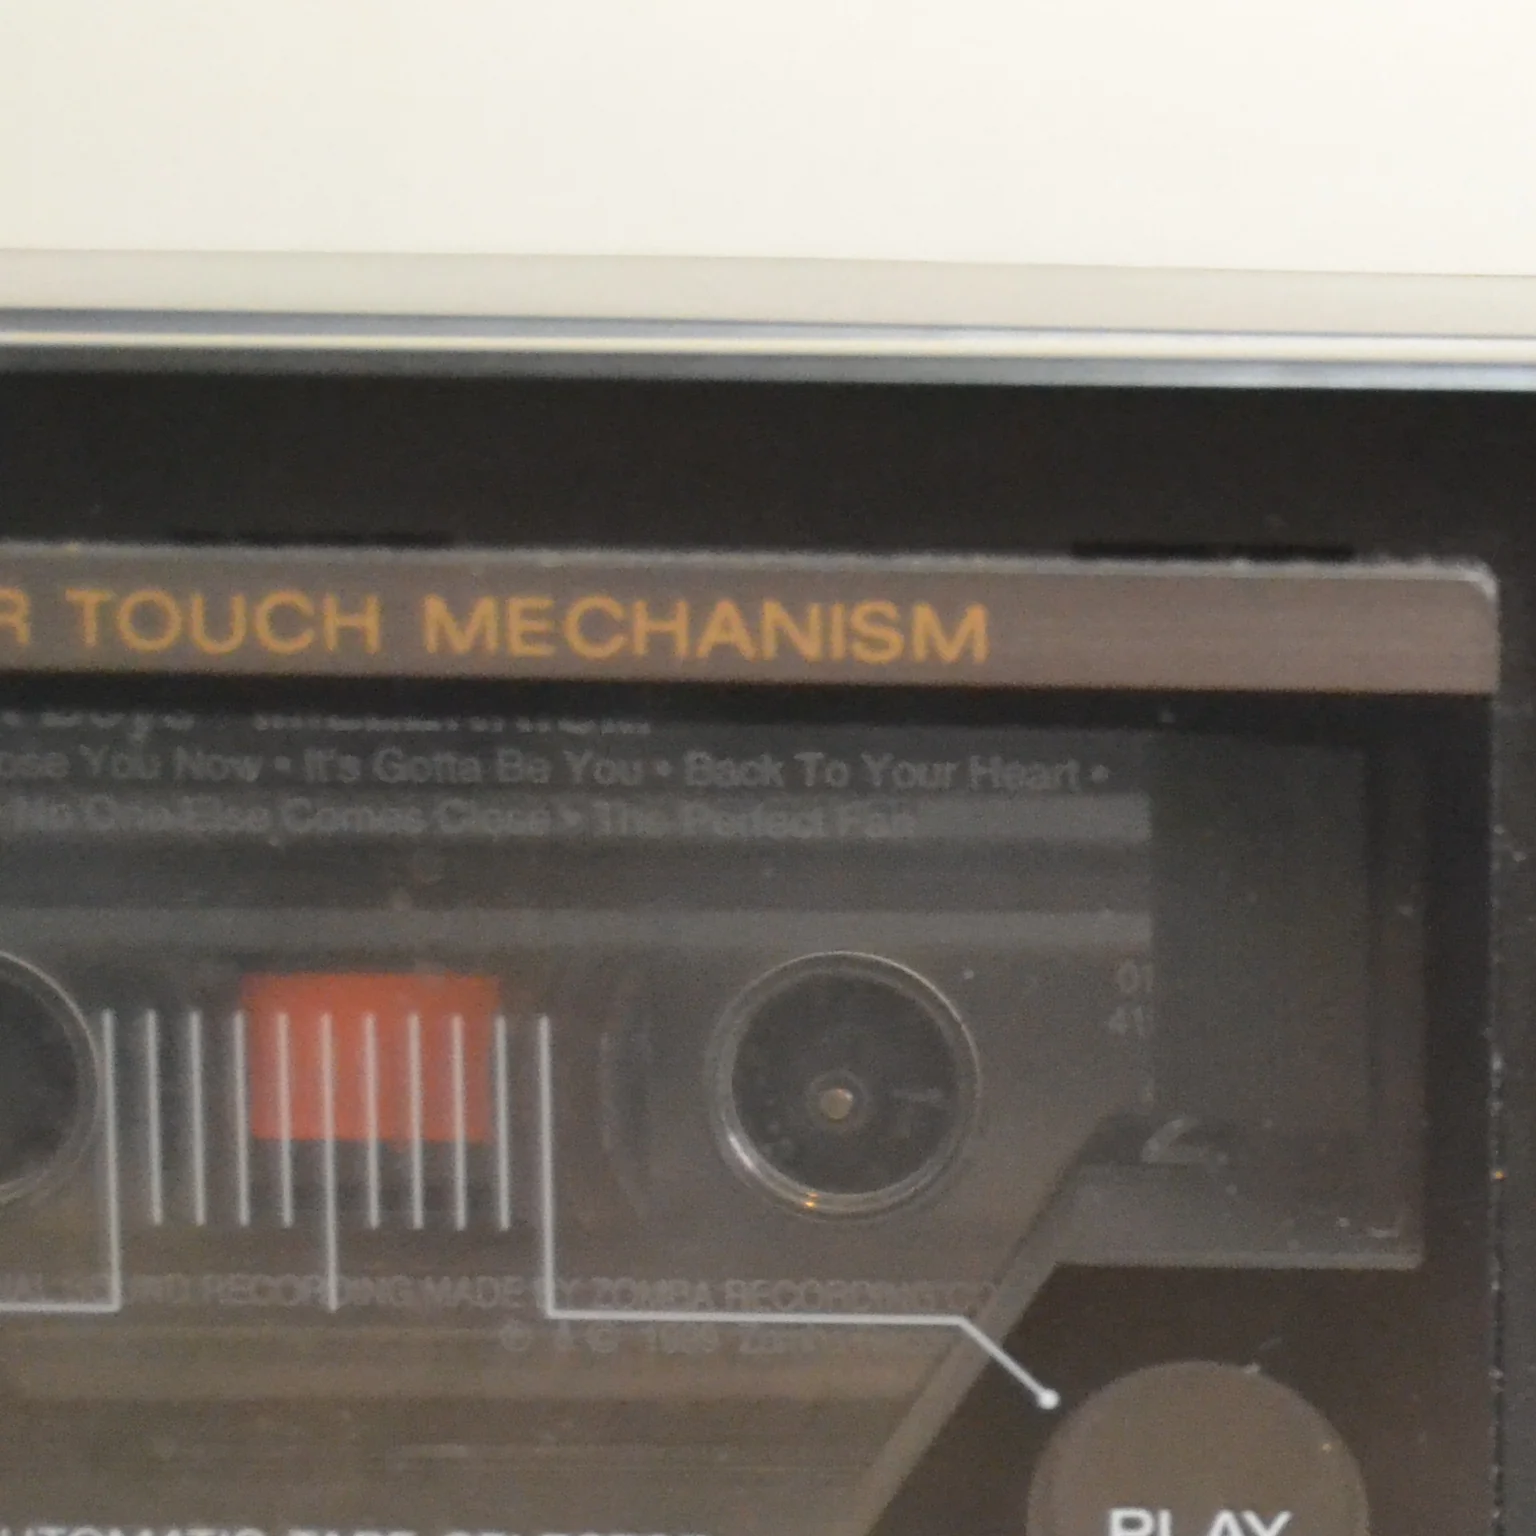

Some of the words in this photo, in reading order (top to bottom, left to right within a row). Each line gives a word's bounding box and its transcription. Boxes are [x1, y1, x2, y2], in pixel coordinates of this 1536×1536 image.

[65, 589, 382, 654] TOUCH
[422, 594, 990, 665] MECHANISM
[563, 749, 643, 787] You
[684, 750, 785, 789] Back
[794, 751, 852, 788] To
[861, 751, 957, 790] Your
